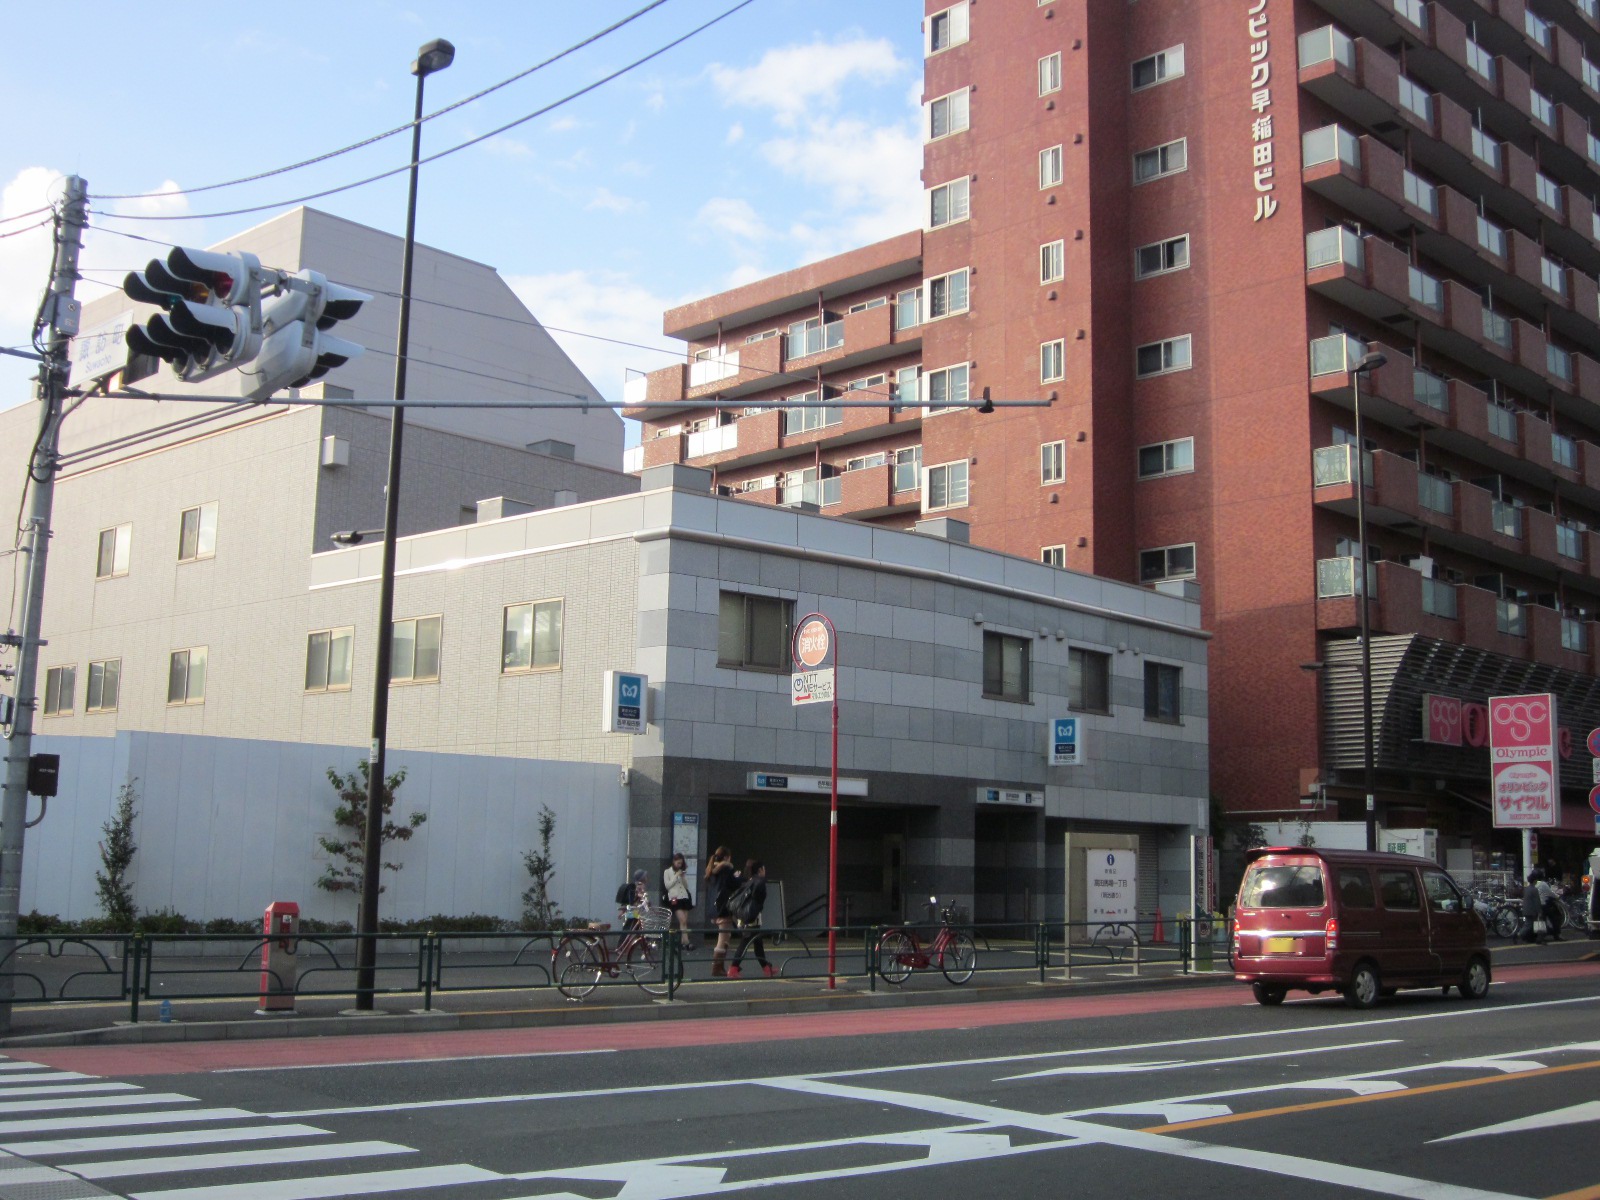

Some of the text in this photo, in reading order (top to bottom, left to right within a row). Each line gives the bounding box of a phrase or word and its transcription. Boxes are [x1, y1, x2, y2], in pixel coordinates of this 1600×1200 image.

[802, 635, 826, 653] 消火栓
[803, 673, 818, 684] NTT
[1496, 747, 1548, 759] Olympic
[1499, 781, 1548, 793] オリンピック
[1499, 794, 1551, 810] サイクル
